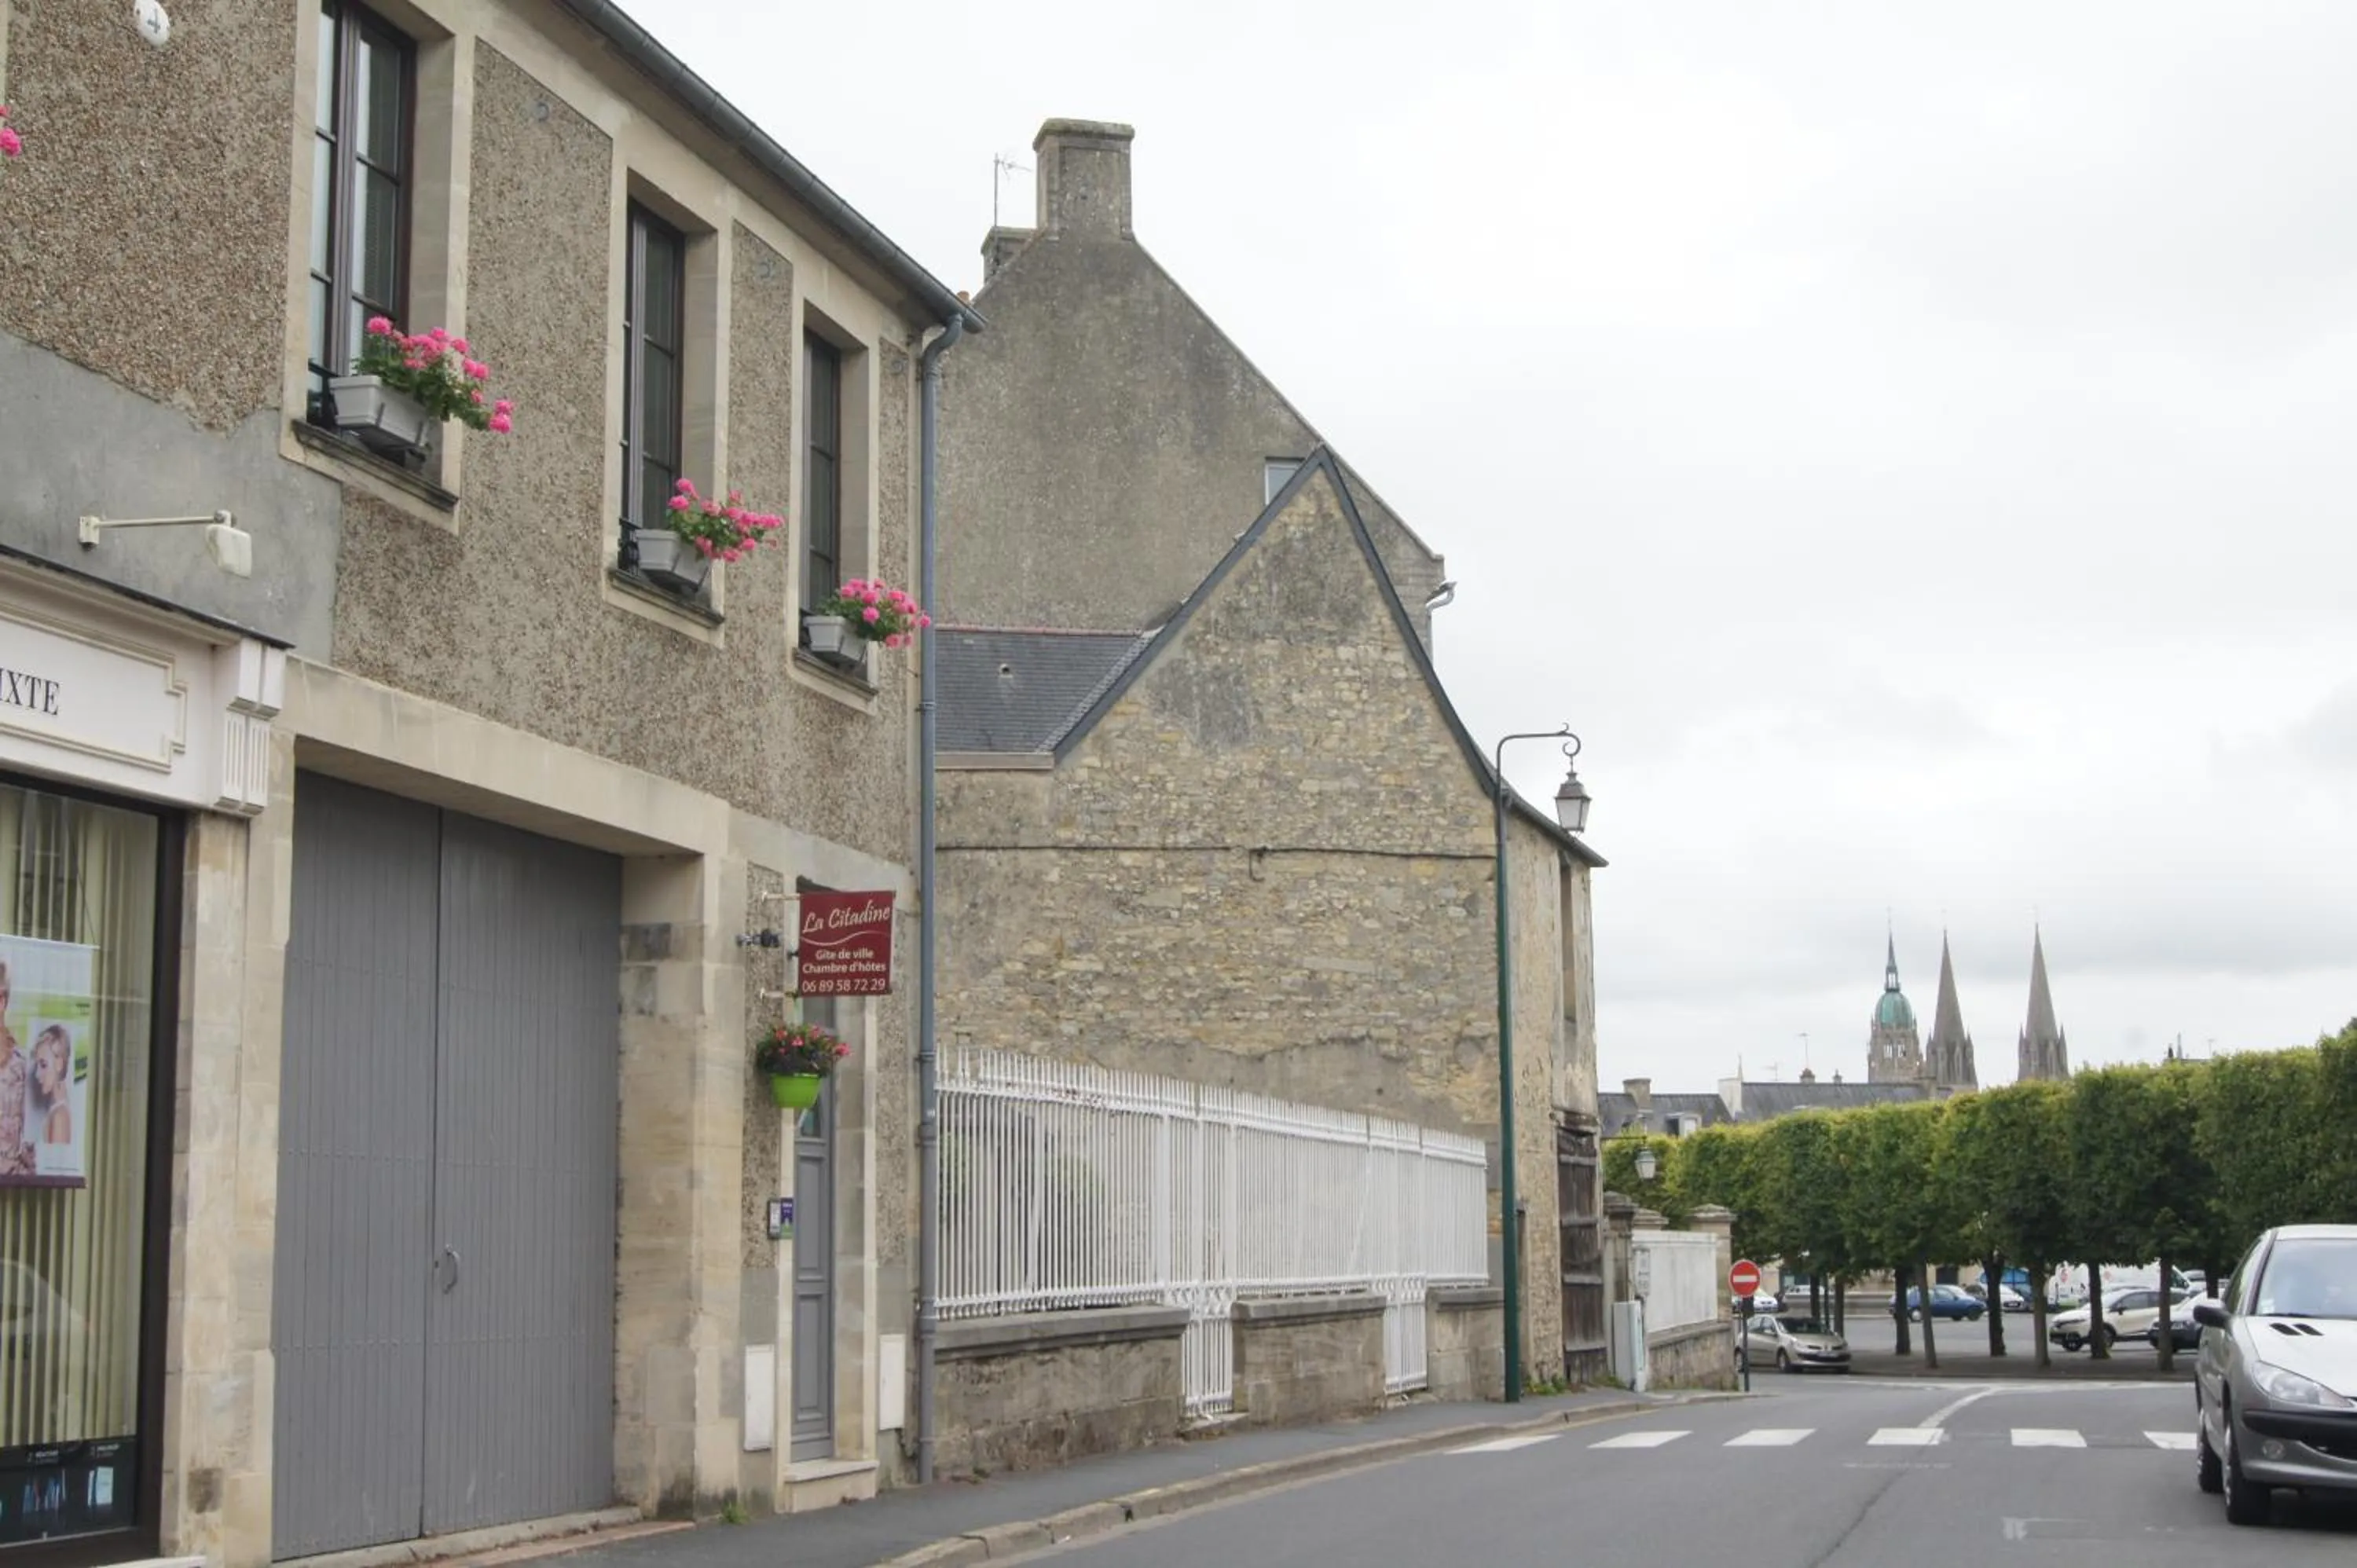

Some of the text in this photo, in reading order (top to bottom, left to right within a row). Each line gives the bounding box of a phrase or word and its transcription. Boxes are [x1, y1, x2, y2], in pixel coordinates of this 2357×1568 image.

[802, 899, 890, 934] La Citadine
[838, 947, 851, 959] de
[852, 947, 874, 958] ville
[802, 962, 848, 973] Chambre
[801, 977, 885, 992] 06 89 58 72 29
